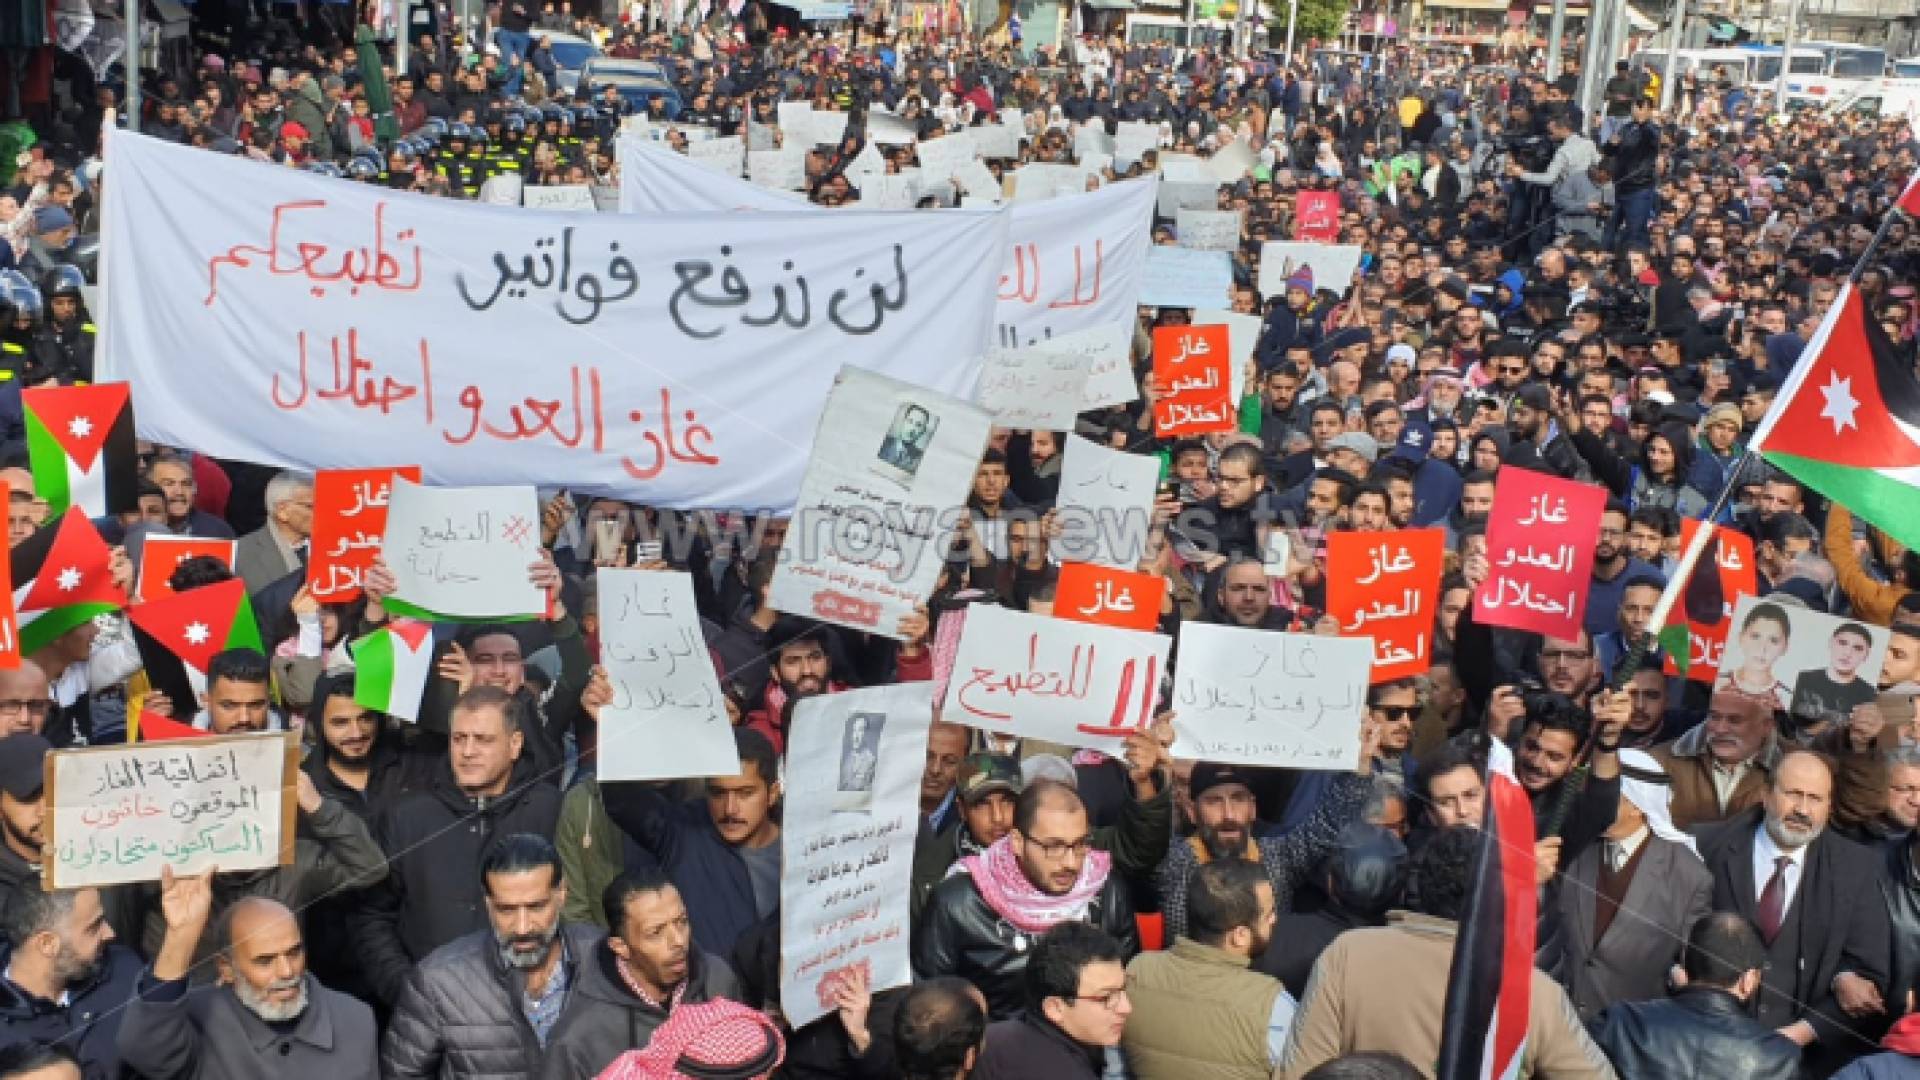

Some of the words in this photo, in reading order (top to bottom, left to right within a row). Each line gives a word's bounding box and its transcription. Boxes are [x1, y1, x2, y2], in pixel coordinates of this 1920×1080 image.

[203, 200, 422, 306] تطبيعكم
[454, 226, 639, 325] فواتير
[669, 245, 811, 340] ندفع
[828, 243, 907, 335] لن
[1170, 335, 1210, 363] غاز
[271, 327, 434, 425] احتلال
[1166, 367, 1218, 397] العدو
[441, 366, 603, 454] العدو
[1158, 403, 1226, 431] احتلال
[620, 386, 720, 480] غاز
[1516, 493, 1569, 525] غاز
[1356, 543, 1416, 584] غاز
[1497, 543, 1574, 572] العدو
[1714, 536, 1744, 570] غا
[1079, 580, 1135, 614] غاز
[1343, 589, 1419, 631] العدو
[1482, 578, 1575, 619] احتلال
[958, 633, 1094, 722] للتطبيع
[89, 756, 146, 797] الغاز
